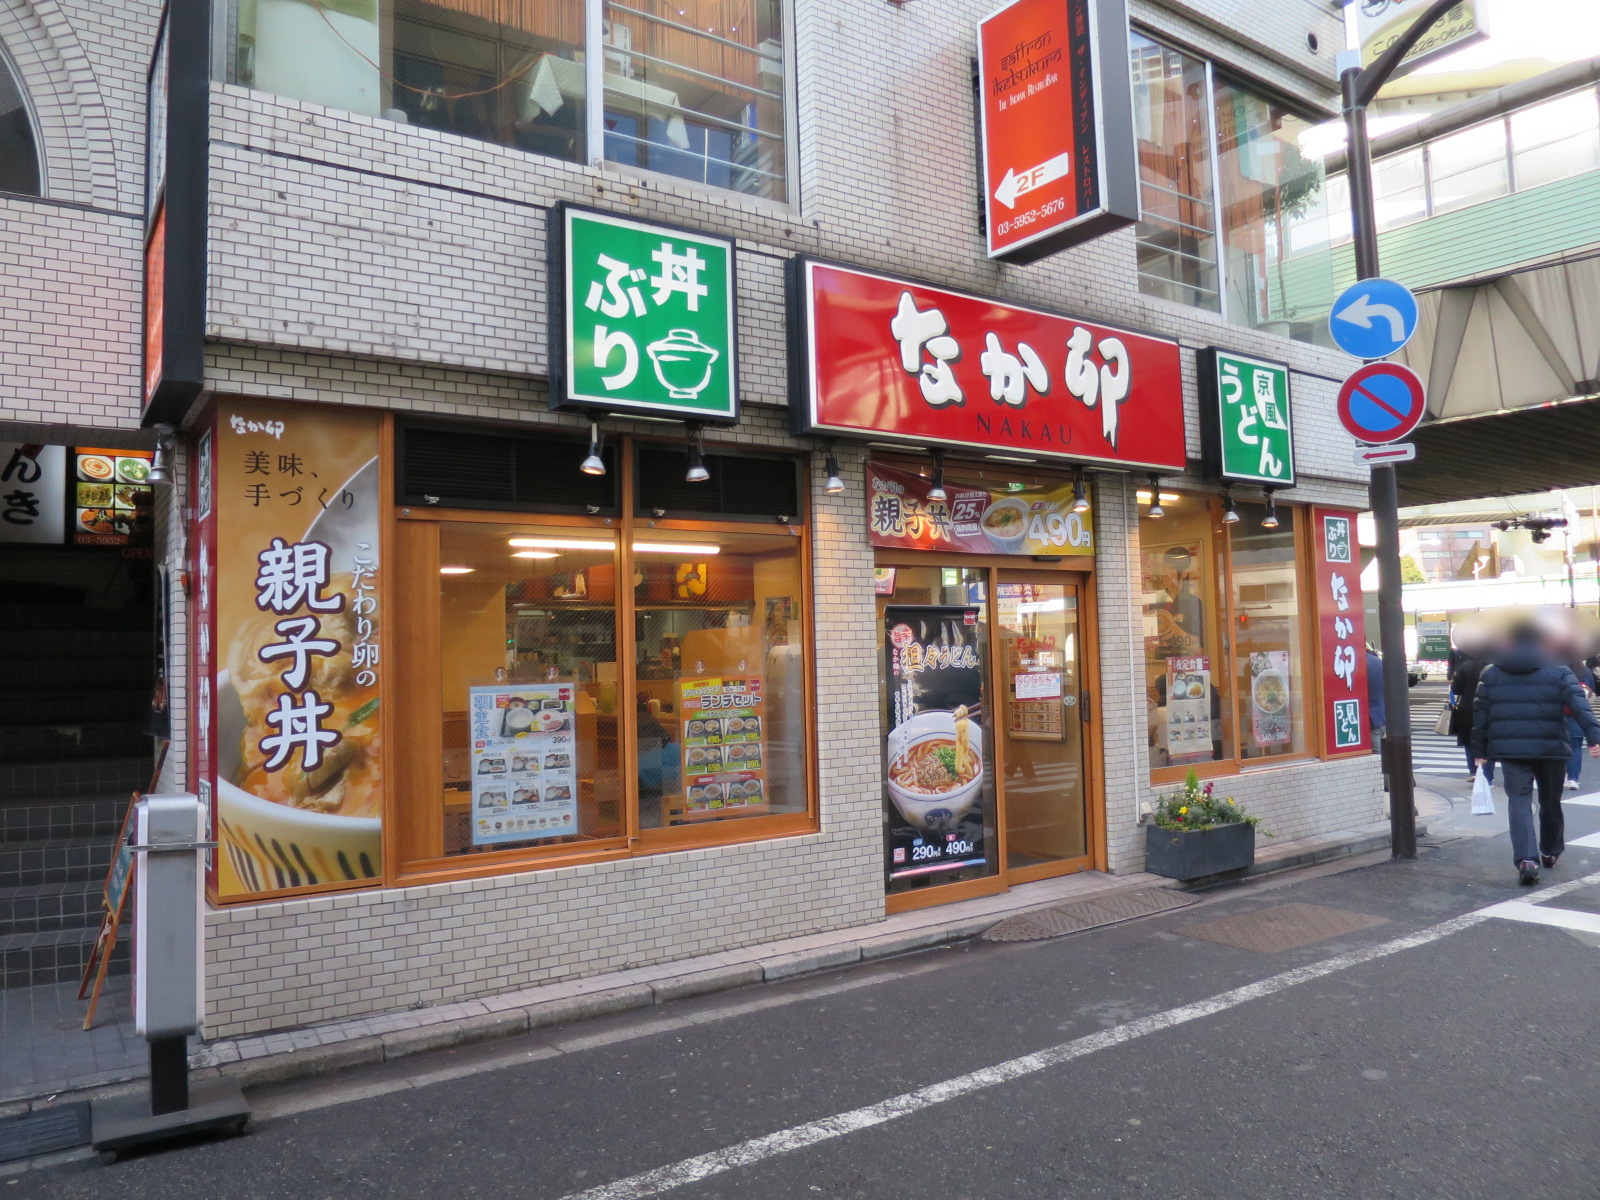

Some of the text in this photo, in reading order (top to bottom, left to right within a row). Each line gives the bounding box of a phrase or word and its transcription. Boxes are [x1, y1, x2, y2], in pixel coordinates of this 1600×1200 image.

[999, 30, 1052, 71] saffron
[992, 47, 1062, 97] ikebukuro
[1016, 165, 1045, 194] 2F
[997, 196, 1065, 237] 03-5952-5676
[891, 290, 1132, 450] なか卯
[1256, 373, 1278, 425] 京風
[230, 414, 285, 439] なか卯
[976, 412, 1073, 446] NAKAU
[1221, 362, 1283, 478] うどん
[243, 450, 321, 479] 美味、
[1, 448, 42, 525] んき
[244, 484, 355, 511] 手づくり
[871, 493, 951, 540] 親子丼
[953, 502, 981, 521] 25%
[1028, 511, 1092, 548] 490円
[77, 536, 128, 546] 03-5952-
[351, 542, 379, 687] こだわり卵の
[1330, 571, 1355, 691] なか卯
[255, 537, 346, 774] 親子丼
[900, 641, 977, 674] 担々うどん
[701, 692, 761, 709] ランチセット
